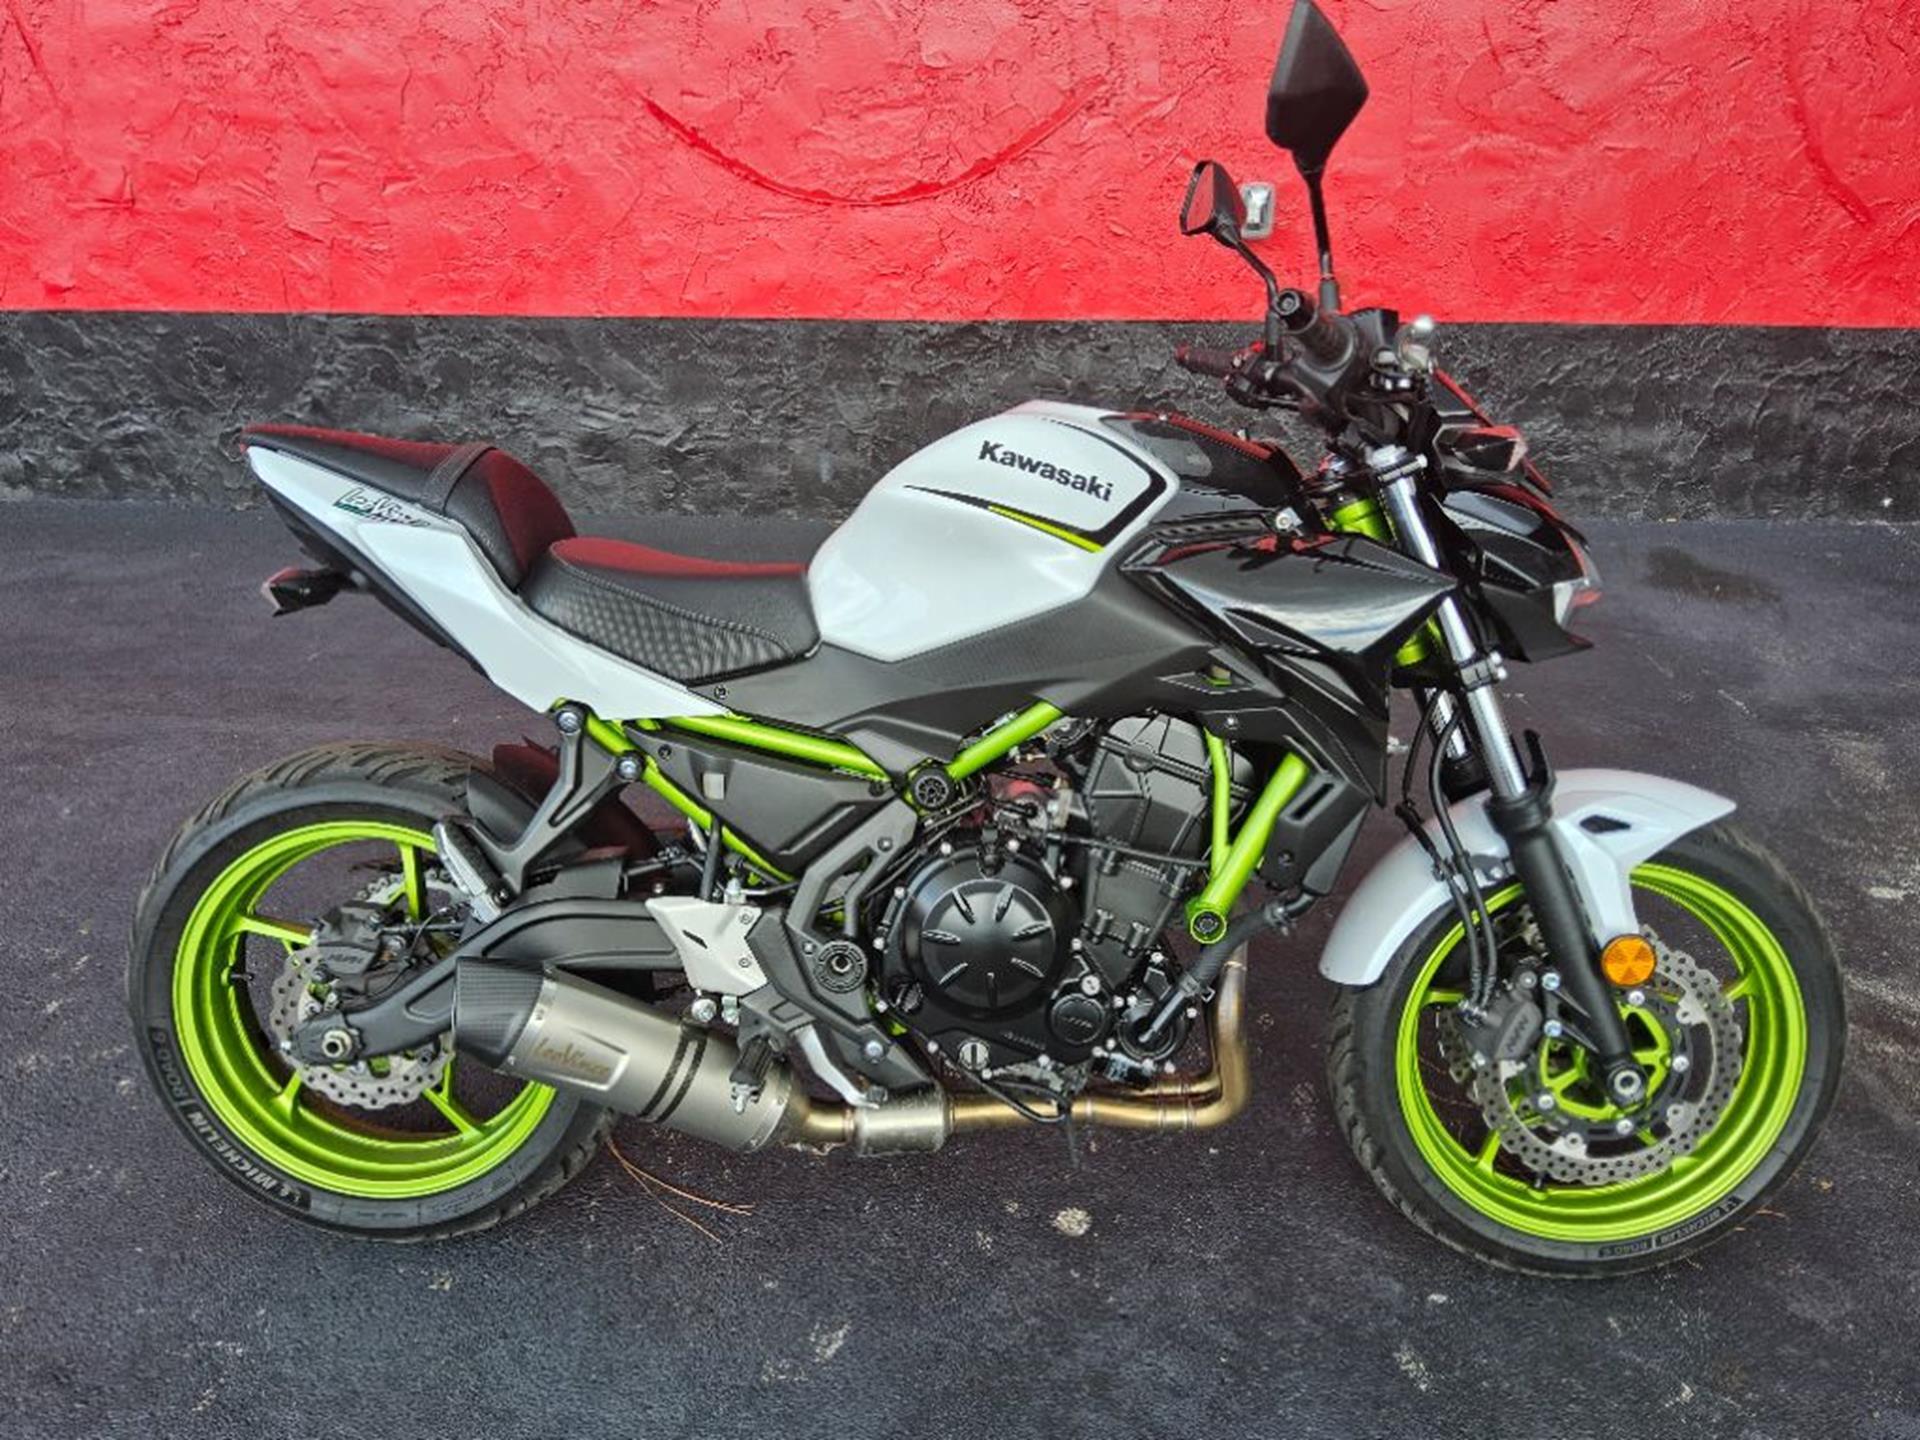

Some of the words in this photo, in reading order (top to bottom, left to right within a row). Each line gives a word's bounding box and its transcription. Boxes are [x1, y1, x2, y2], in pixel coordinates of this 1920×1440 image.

[978, 440, 1114, 502] Kawasaki
[157, 1048, 190, 1099] ROAD
[188, 1110, 279, 1191] MICHELIN
